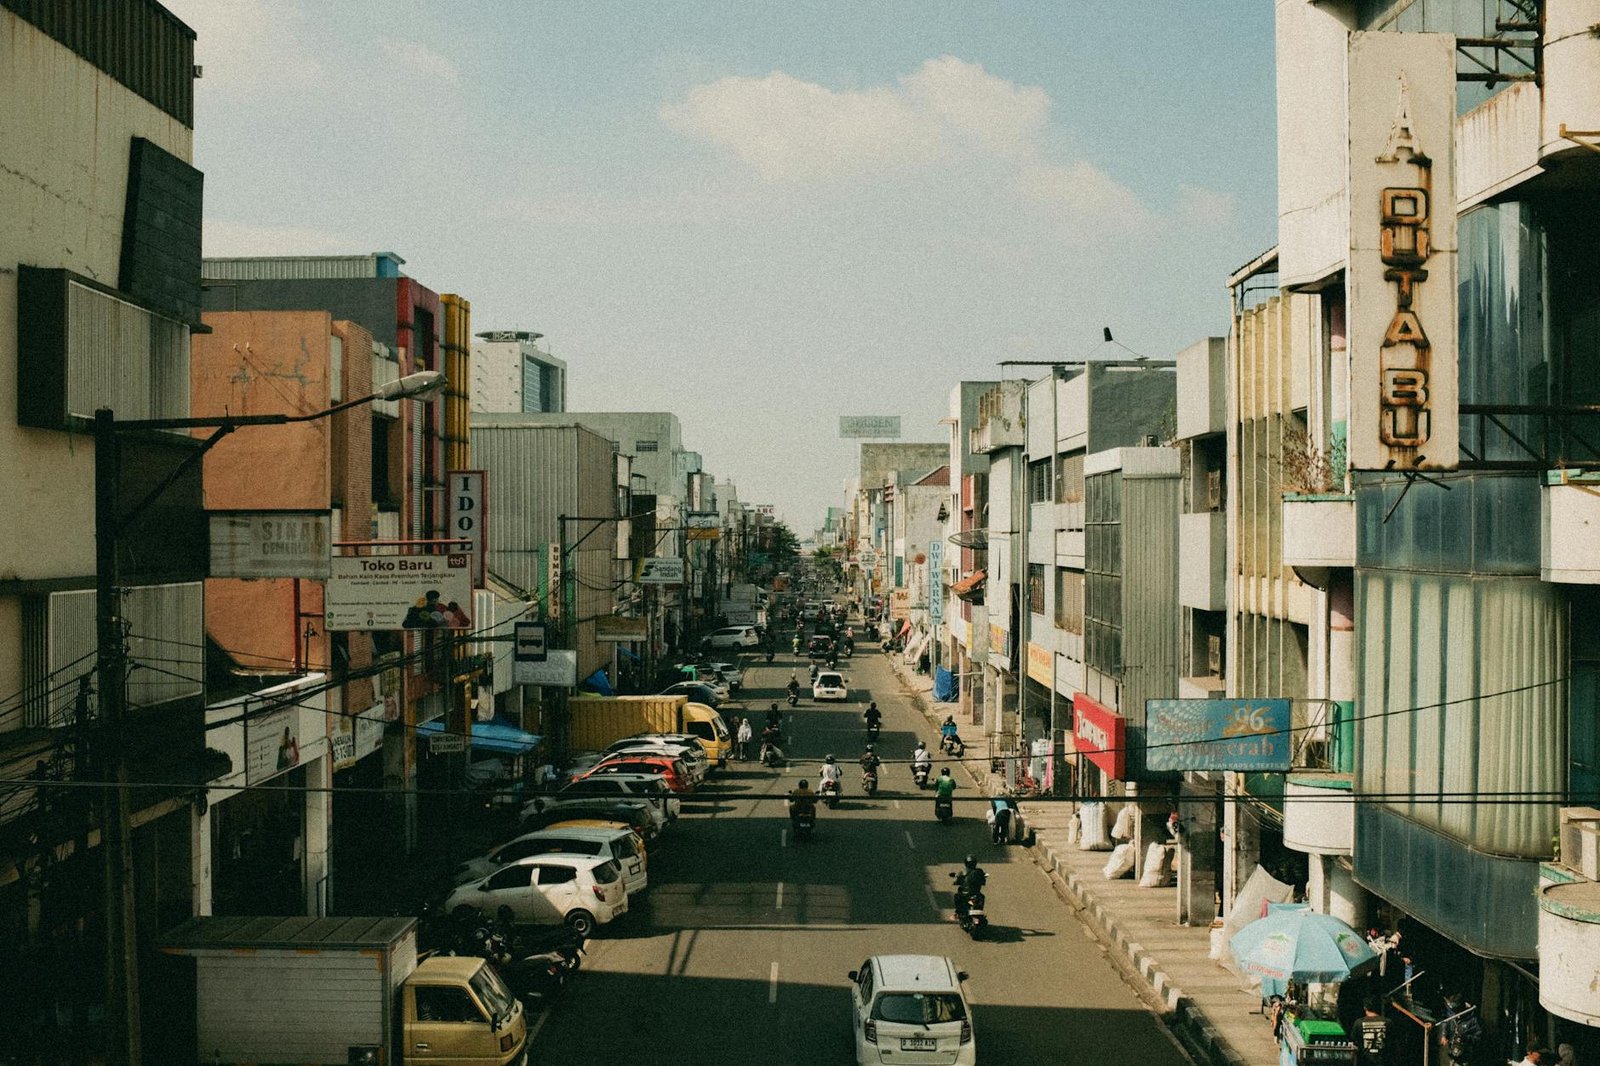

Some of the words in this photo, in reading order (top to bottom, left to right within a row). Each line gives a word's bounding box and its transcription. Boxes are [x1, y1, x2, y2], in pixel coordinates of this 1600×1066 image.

[360, 560, 395, 571] Toko
[399, 559, 433, 571] Baru
[654, 564, 682, 574] Sandang
